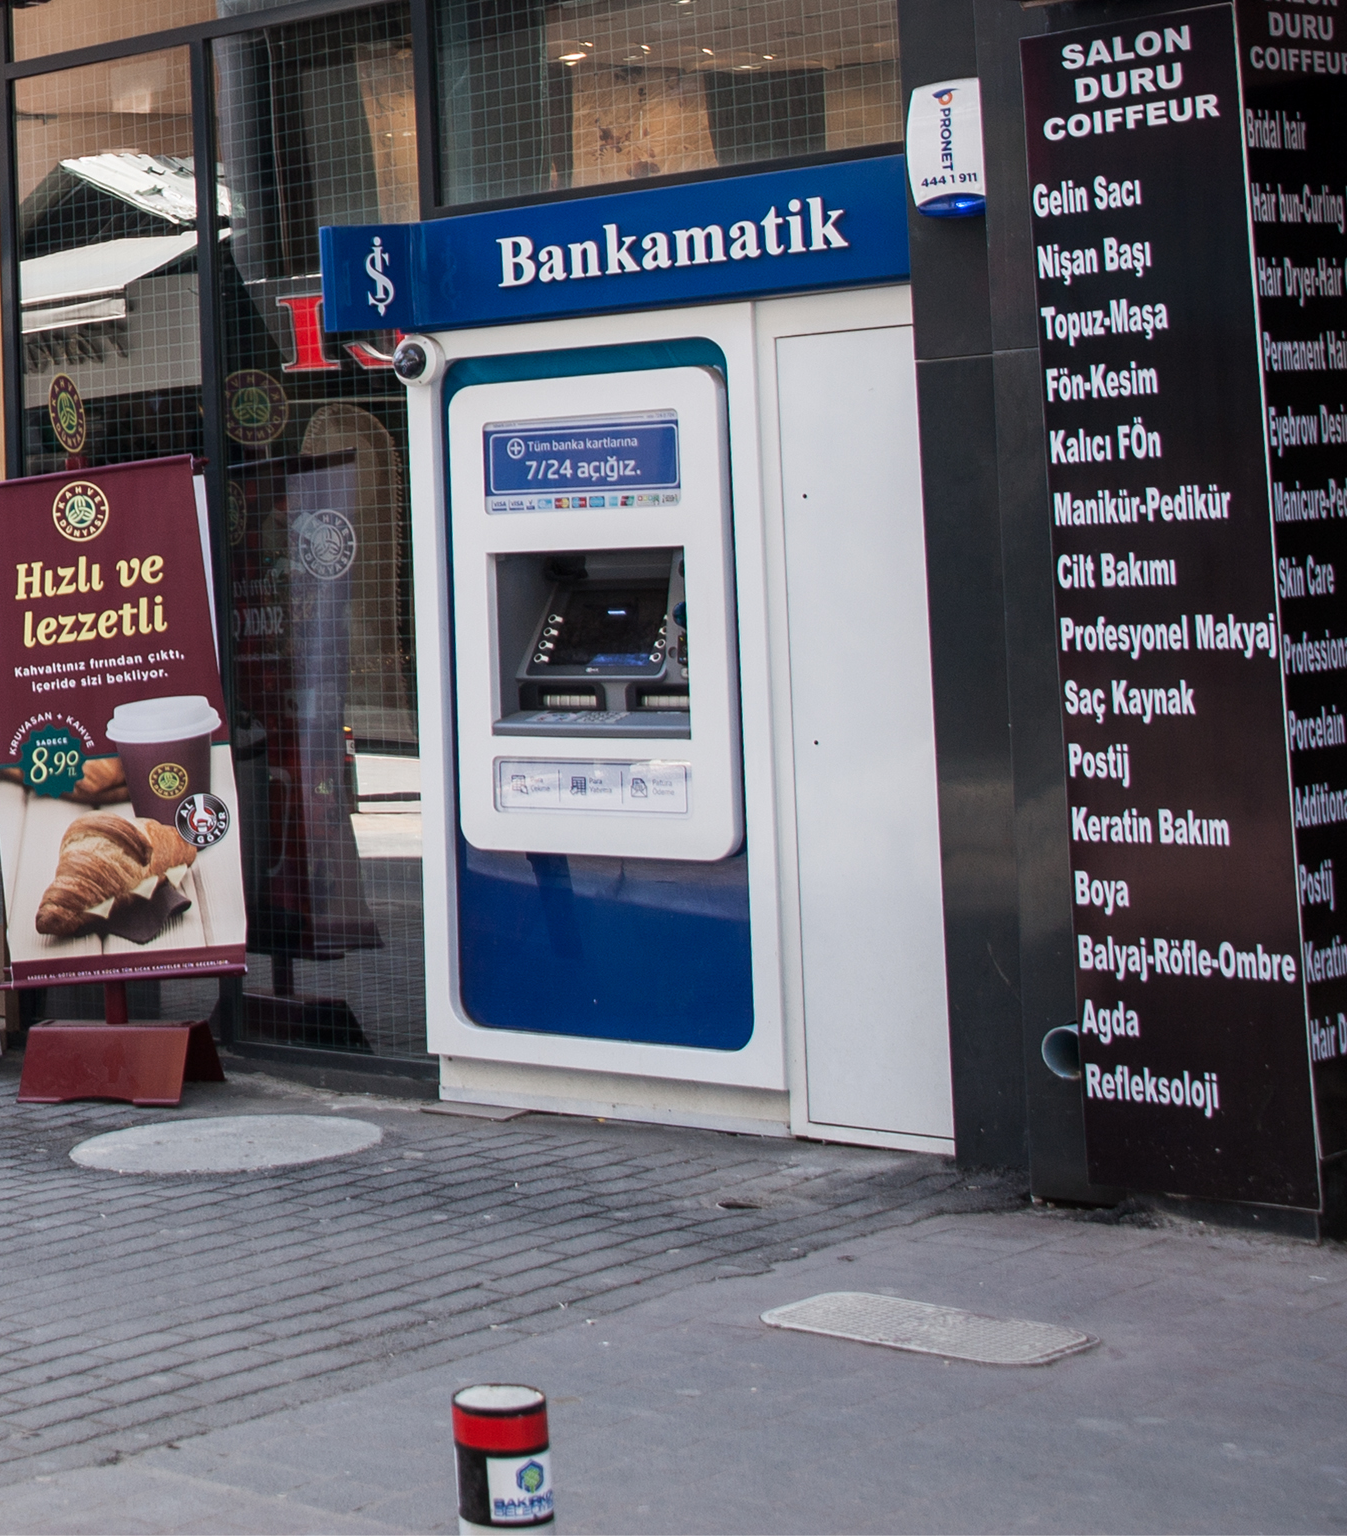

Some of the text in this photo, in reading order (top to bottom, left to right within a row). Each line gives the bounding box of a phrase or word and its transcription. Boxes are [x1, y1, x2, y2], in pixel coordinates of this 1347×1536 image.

[1061, 24, 1192, 71] SALON
[1267, 11, 1334, 41] DURU
[1075, 62, 1184, 104] DURU
[939, 107, 954, 171] PRONET
[1043, 94, 1220, 141] COIFFEUR
[1246, 108, 1307, 151] Bridal hair
[921, 175, 947, 188] 444
[958, 172, 978, 183] 911
[1032, 175, 1142, 218] Gelin Sacı
[1251, 182, 1277, 223] Hair
[497, 195, 850, 289] Bankamatik
[1037, 236, 1152, 286] Nişan Başı
[1257, 256, 1342, 308] Hair Dryer-Hair
[1041, 299, 1169, 346] Topuz-Maşa
[1263, 331, 1326, 372] Permanent
[1045, 361, 1159, 403] Fön-Kesim
[527, 436, 638, 452] Tüm banka kartlarına
[1049, 429, 1112, 465] Kalıcı
[1268, 405, 1318, 458] Eyebrow
[525, 456, 641, 482] 7/24 açığız.
[58, 486, 102, 509] KAHVE
[1053, 484, 1231, 527] Manikür-Pedikür
[15, 554, 164, 600] Hızlı ve
[1057, 551, 1177, 590] Cilt Bakımı
[1278, 554, 1336, 599] Skin Care
[23, 595, 167, 648] lezzetli
[1060, 613, 1277, 660] Profesyonel Makyaj
[14, 659, 86, 678] Kahvaltınız
[106, 667, 168, 685] bekliyor.
[1065, 679, 1196, 724] Saç Kaynak
[9, 711, 53, 756] KRUVASAN
[65, 715, 95, 749] KAHVE
[35, 737, 68, 747] SADECE
[1288, 704, 1346, 752] Porcelain
[30, 746, 79, 784] 8,90
[1068, 743, 1130, 788] Postij
[180, 802, 194, 818] AL
[1071, 806, 1230, 847] Keratin Bakım
[1074, 870, 1130, 916] Boya
[1299, 859, 1336, 912] Postij
[1078, 934, 1296, 984] Balyaj-Röfle-Ombre
[1081, 999, 1140, 1045] Agda
[1310, 1015, 1337, 1063] Hair
[1085, 1062, 1219, 1118] Refleksoloji
